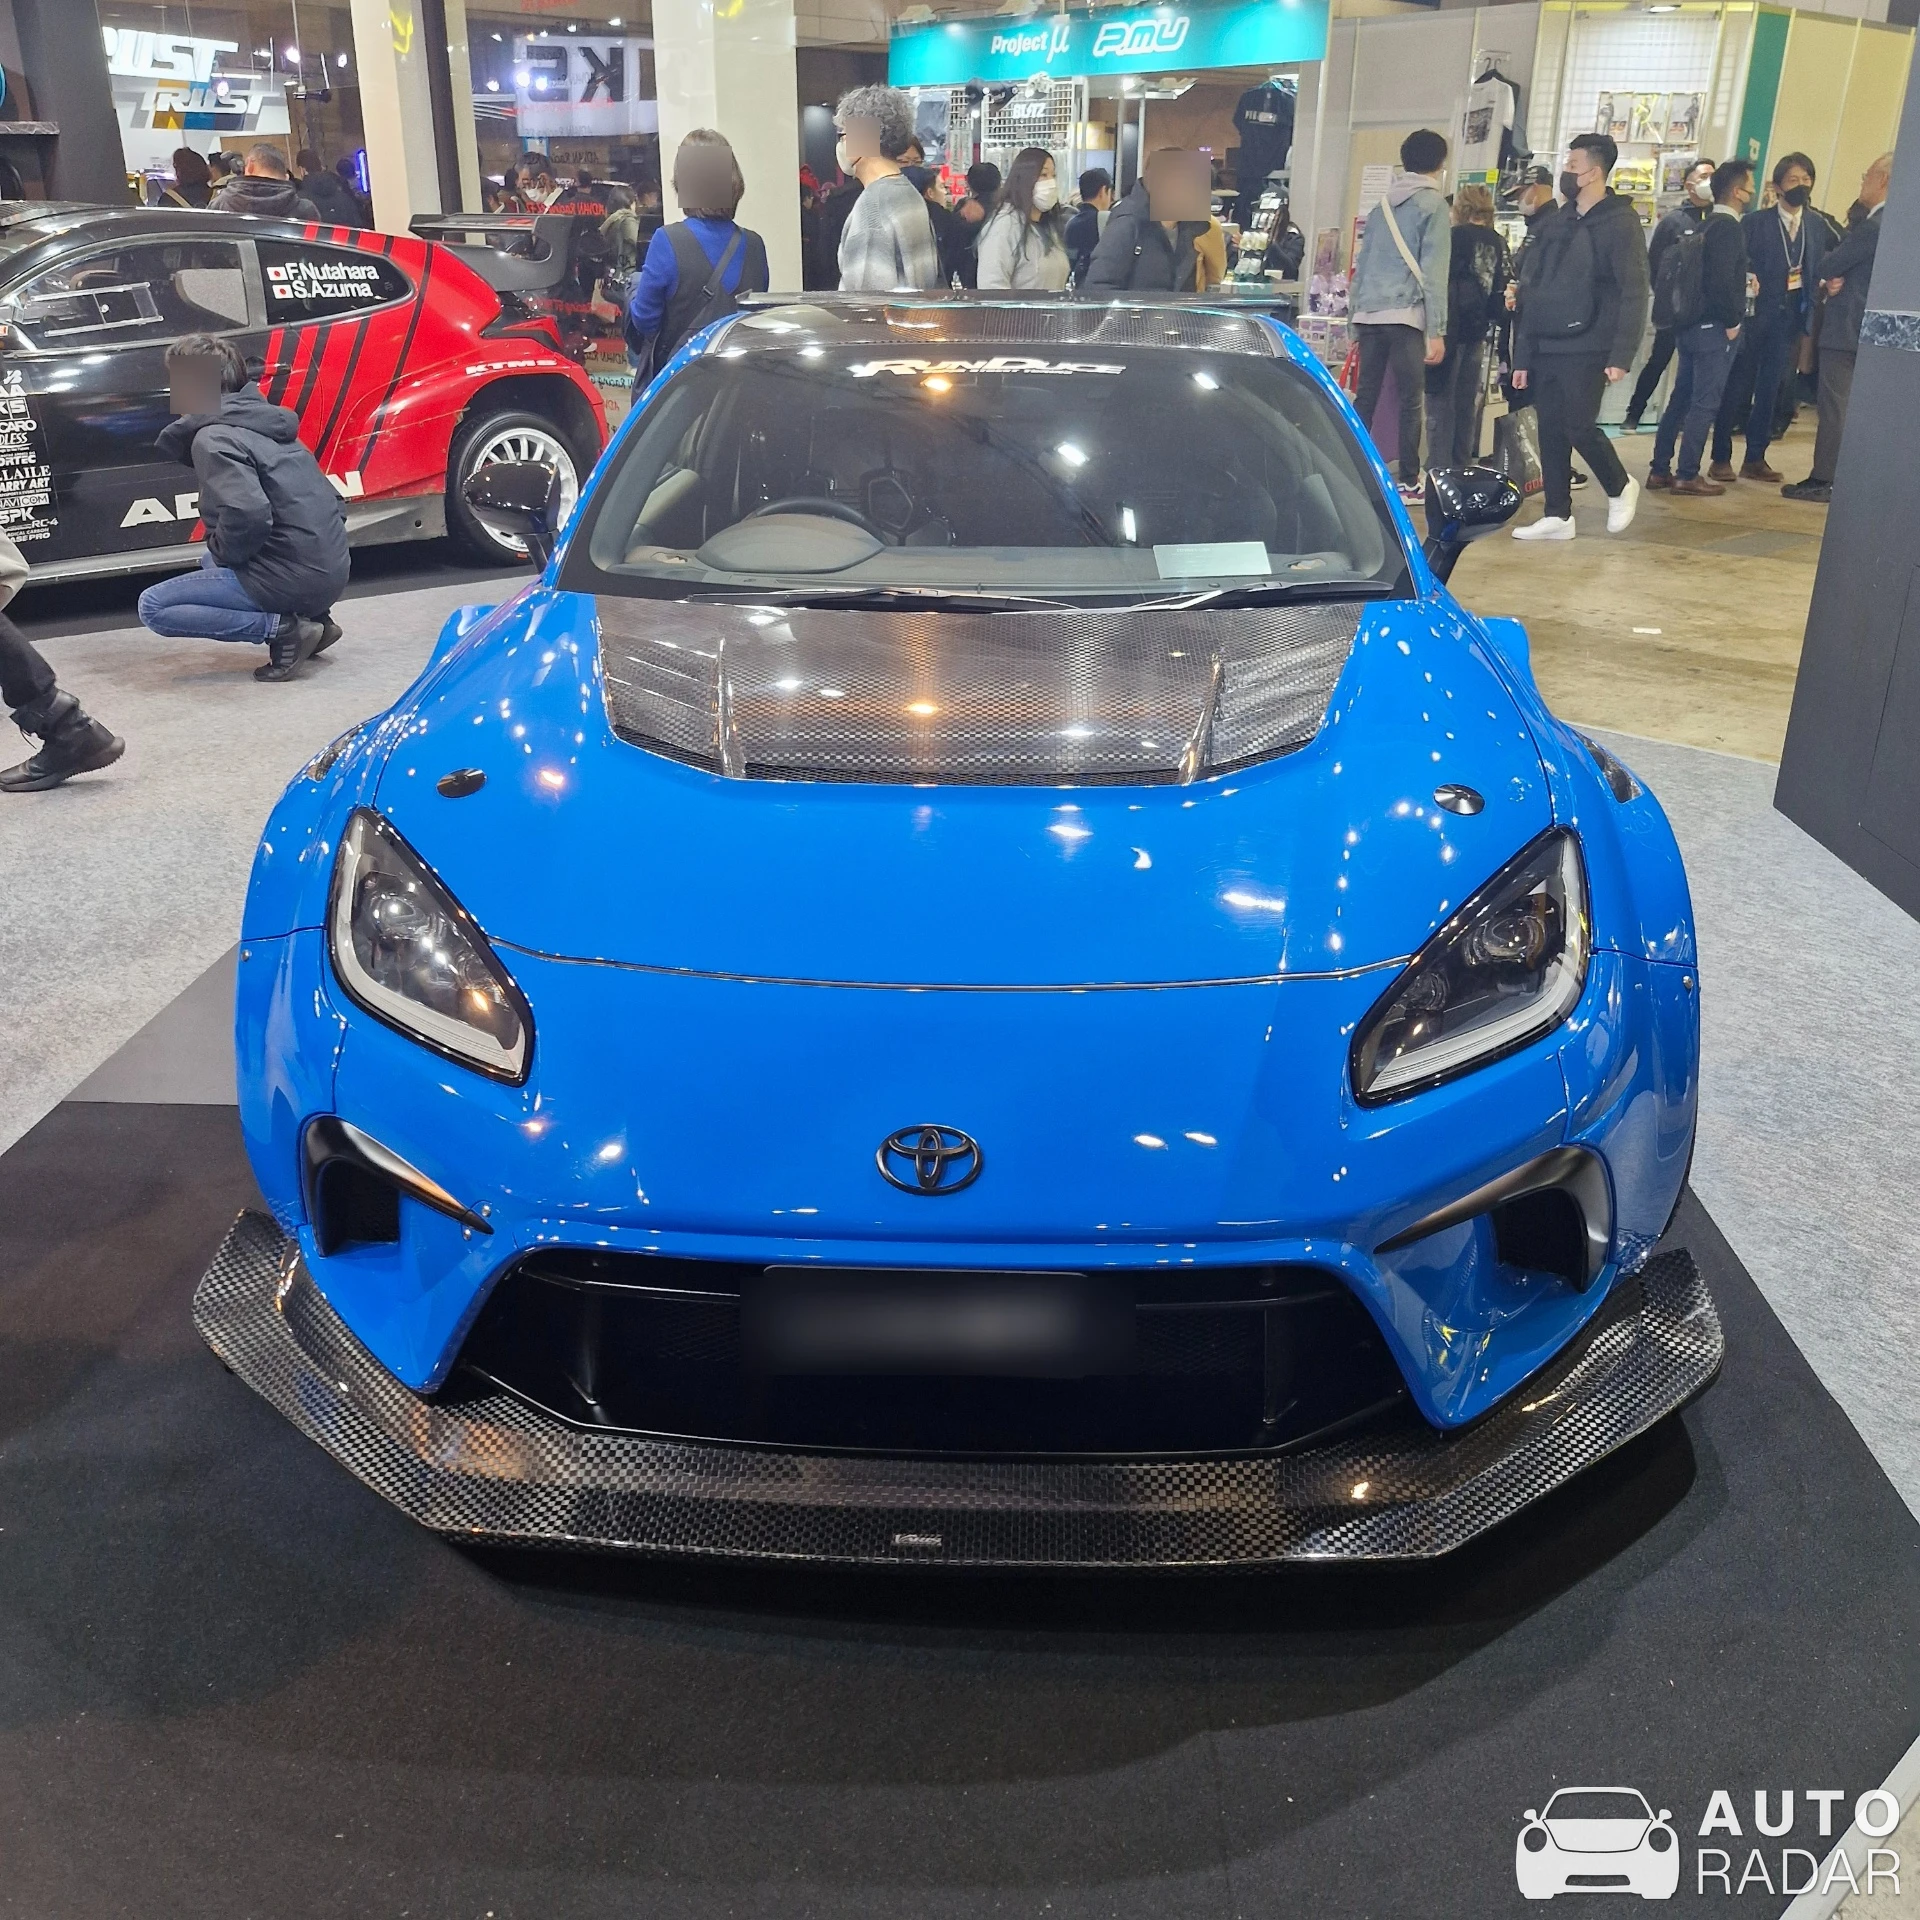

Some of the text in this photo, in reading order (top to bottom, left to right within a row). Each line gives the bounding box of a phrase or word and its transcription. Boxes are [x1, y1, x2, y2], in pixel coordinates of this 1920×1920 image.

[991, 31, 1048, 57] Project
[140, 86, 281, 114] TRUST
[1012, 102, 1047, 119] BLITZ
[285, 262, 379, 281] F.Nutahara
[292, 279, 373, 299] S.Azuma
[465, 359, 557, 375] KTMS
[29, 477, 50, 489] ART
